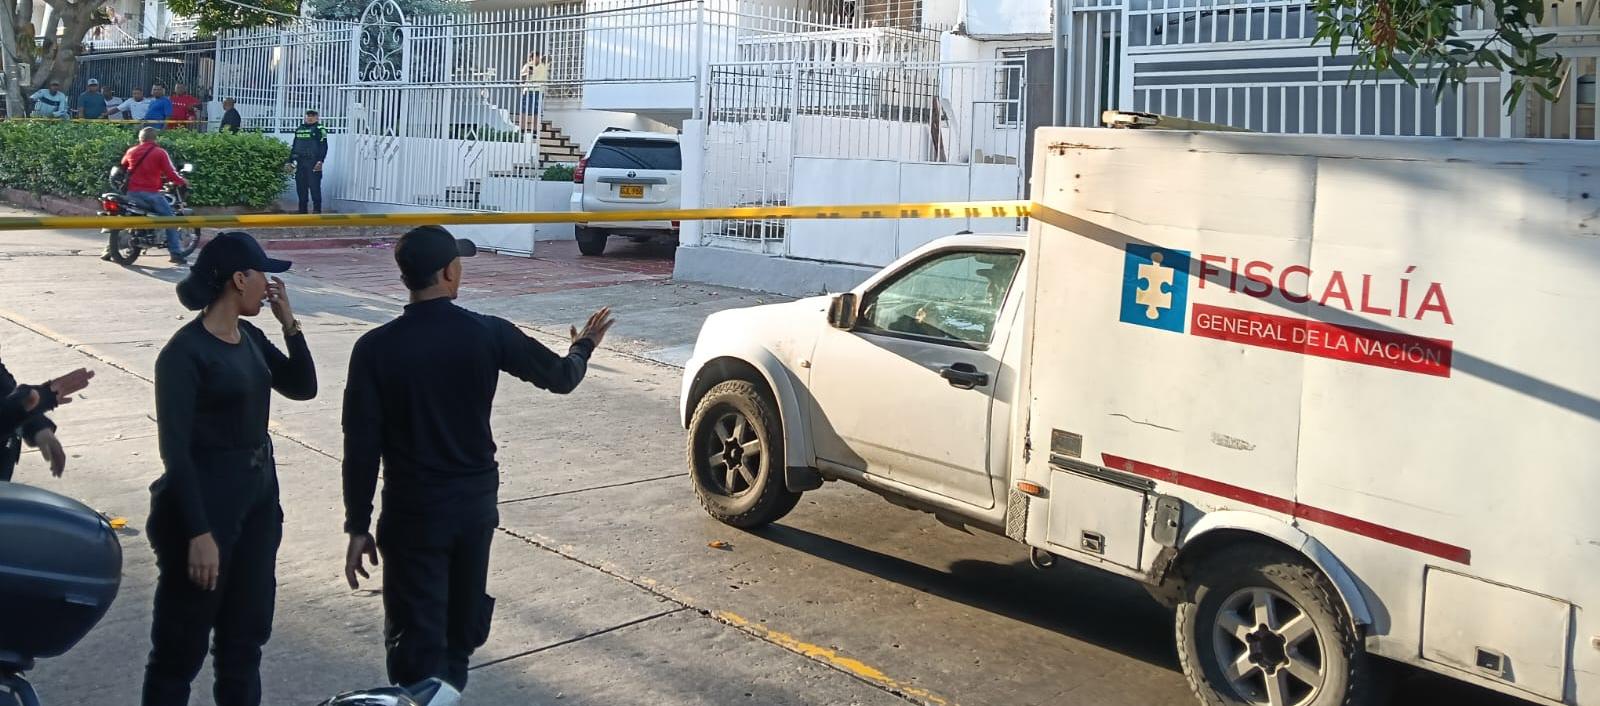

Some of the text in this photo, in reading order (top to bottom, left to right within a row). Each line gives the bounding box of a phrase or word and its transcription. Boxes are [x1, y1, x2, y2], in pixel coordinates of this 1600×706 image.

[1198, 253, 1454, 325] FISCALÍA
[1196, 313, 1442, 367] GENERAL DE LA NACIÓN
